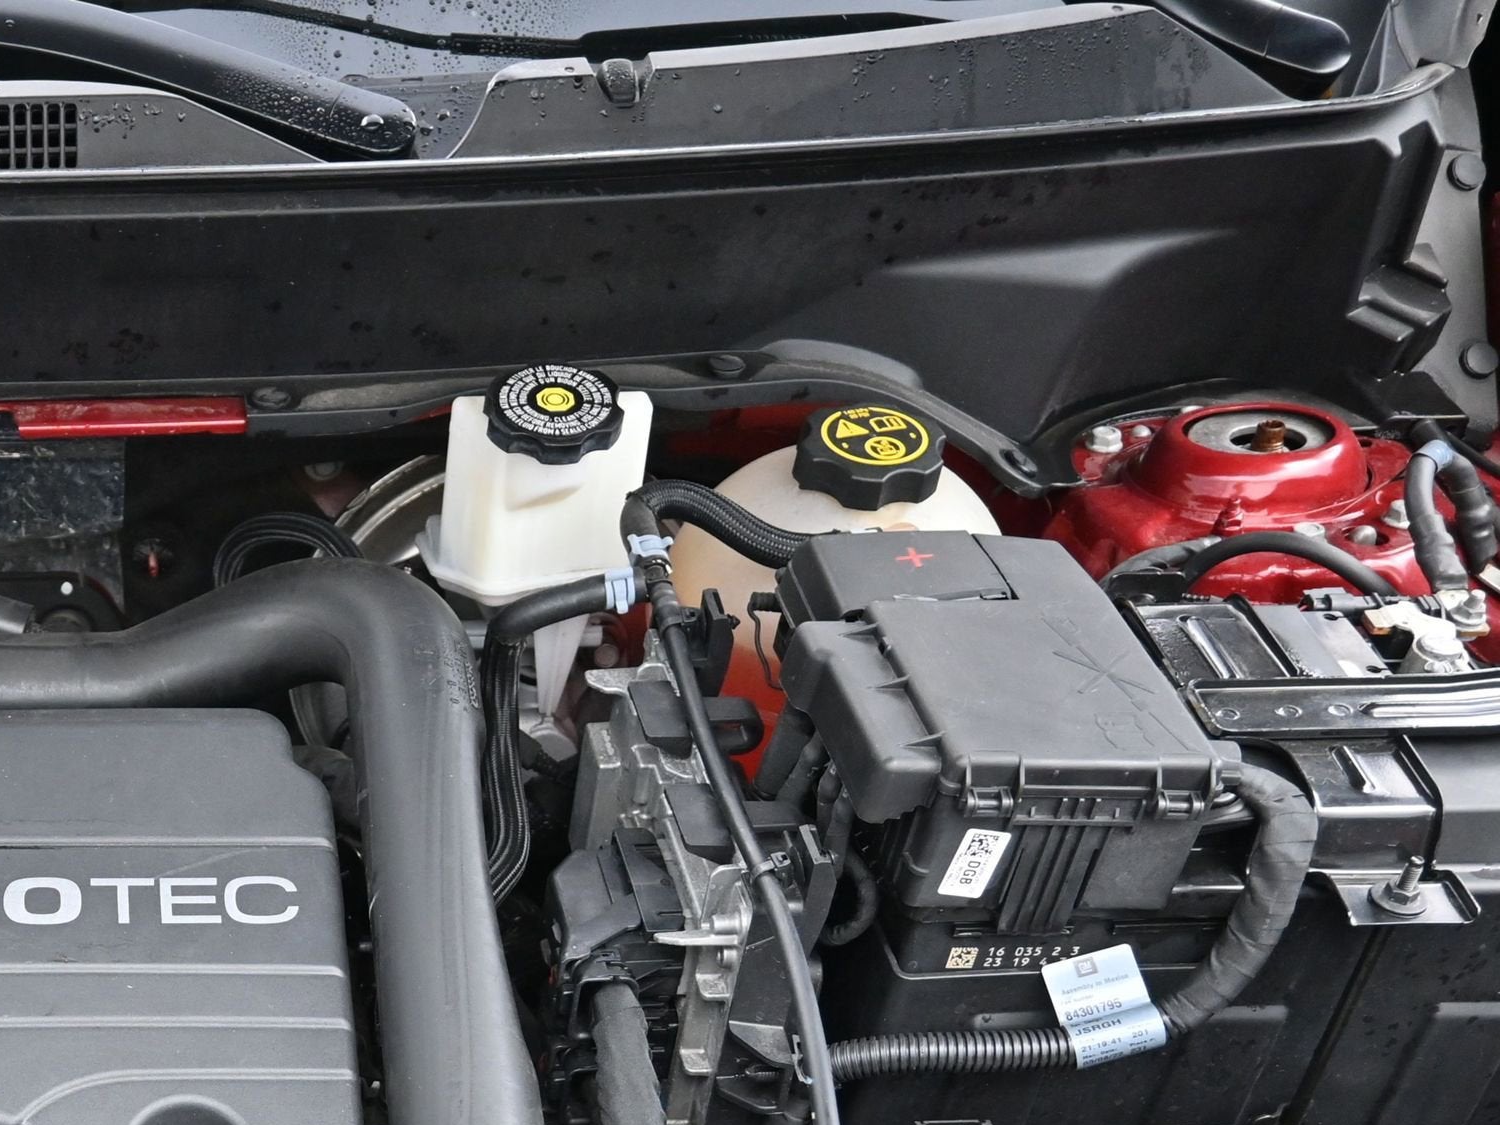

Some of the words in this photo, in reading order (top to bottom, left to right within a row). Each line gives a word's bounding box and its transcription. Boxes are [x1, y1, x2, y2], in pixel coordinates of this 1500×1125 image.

[506, 367, 535, 385] NETTOYER
[545, 365, 577, 374] BOUCHON
[577, 370, 599, 382] AVANT
[594, 380, 604, 388] LA
[512, 406, 525, 415] CAP
[521, 413, 546, 427] BEFORE
[580, 414, 594, 423] USE
[554, 414, 577, 423] CLEAN
[514, 418, 535, 431] FLUID
[533, 426, 555, 435] FROM
[560, 424, 587, 436] SEALED
[959, 860, 981, 885] DGB
[988, 947, 1006, 957] 16
[1014, 947, 1043, 957] 035
[1051, 946, 1062, 956] 2
[1069, 946, 1080, 956] 3
[983, 957, 1003, 967] 23
[1012, 957, 1031, 967] 19
[1065, 998, 1122, 1021] 84301795
[1075, 1018, 1122, 1036] JSRGH
